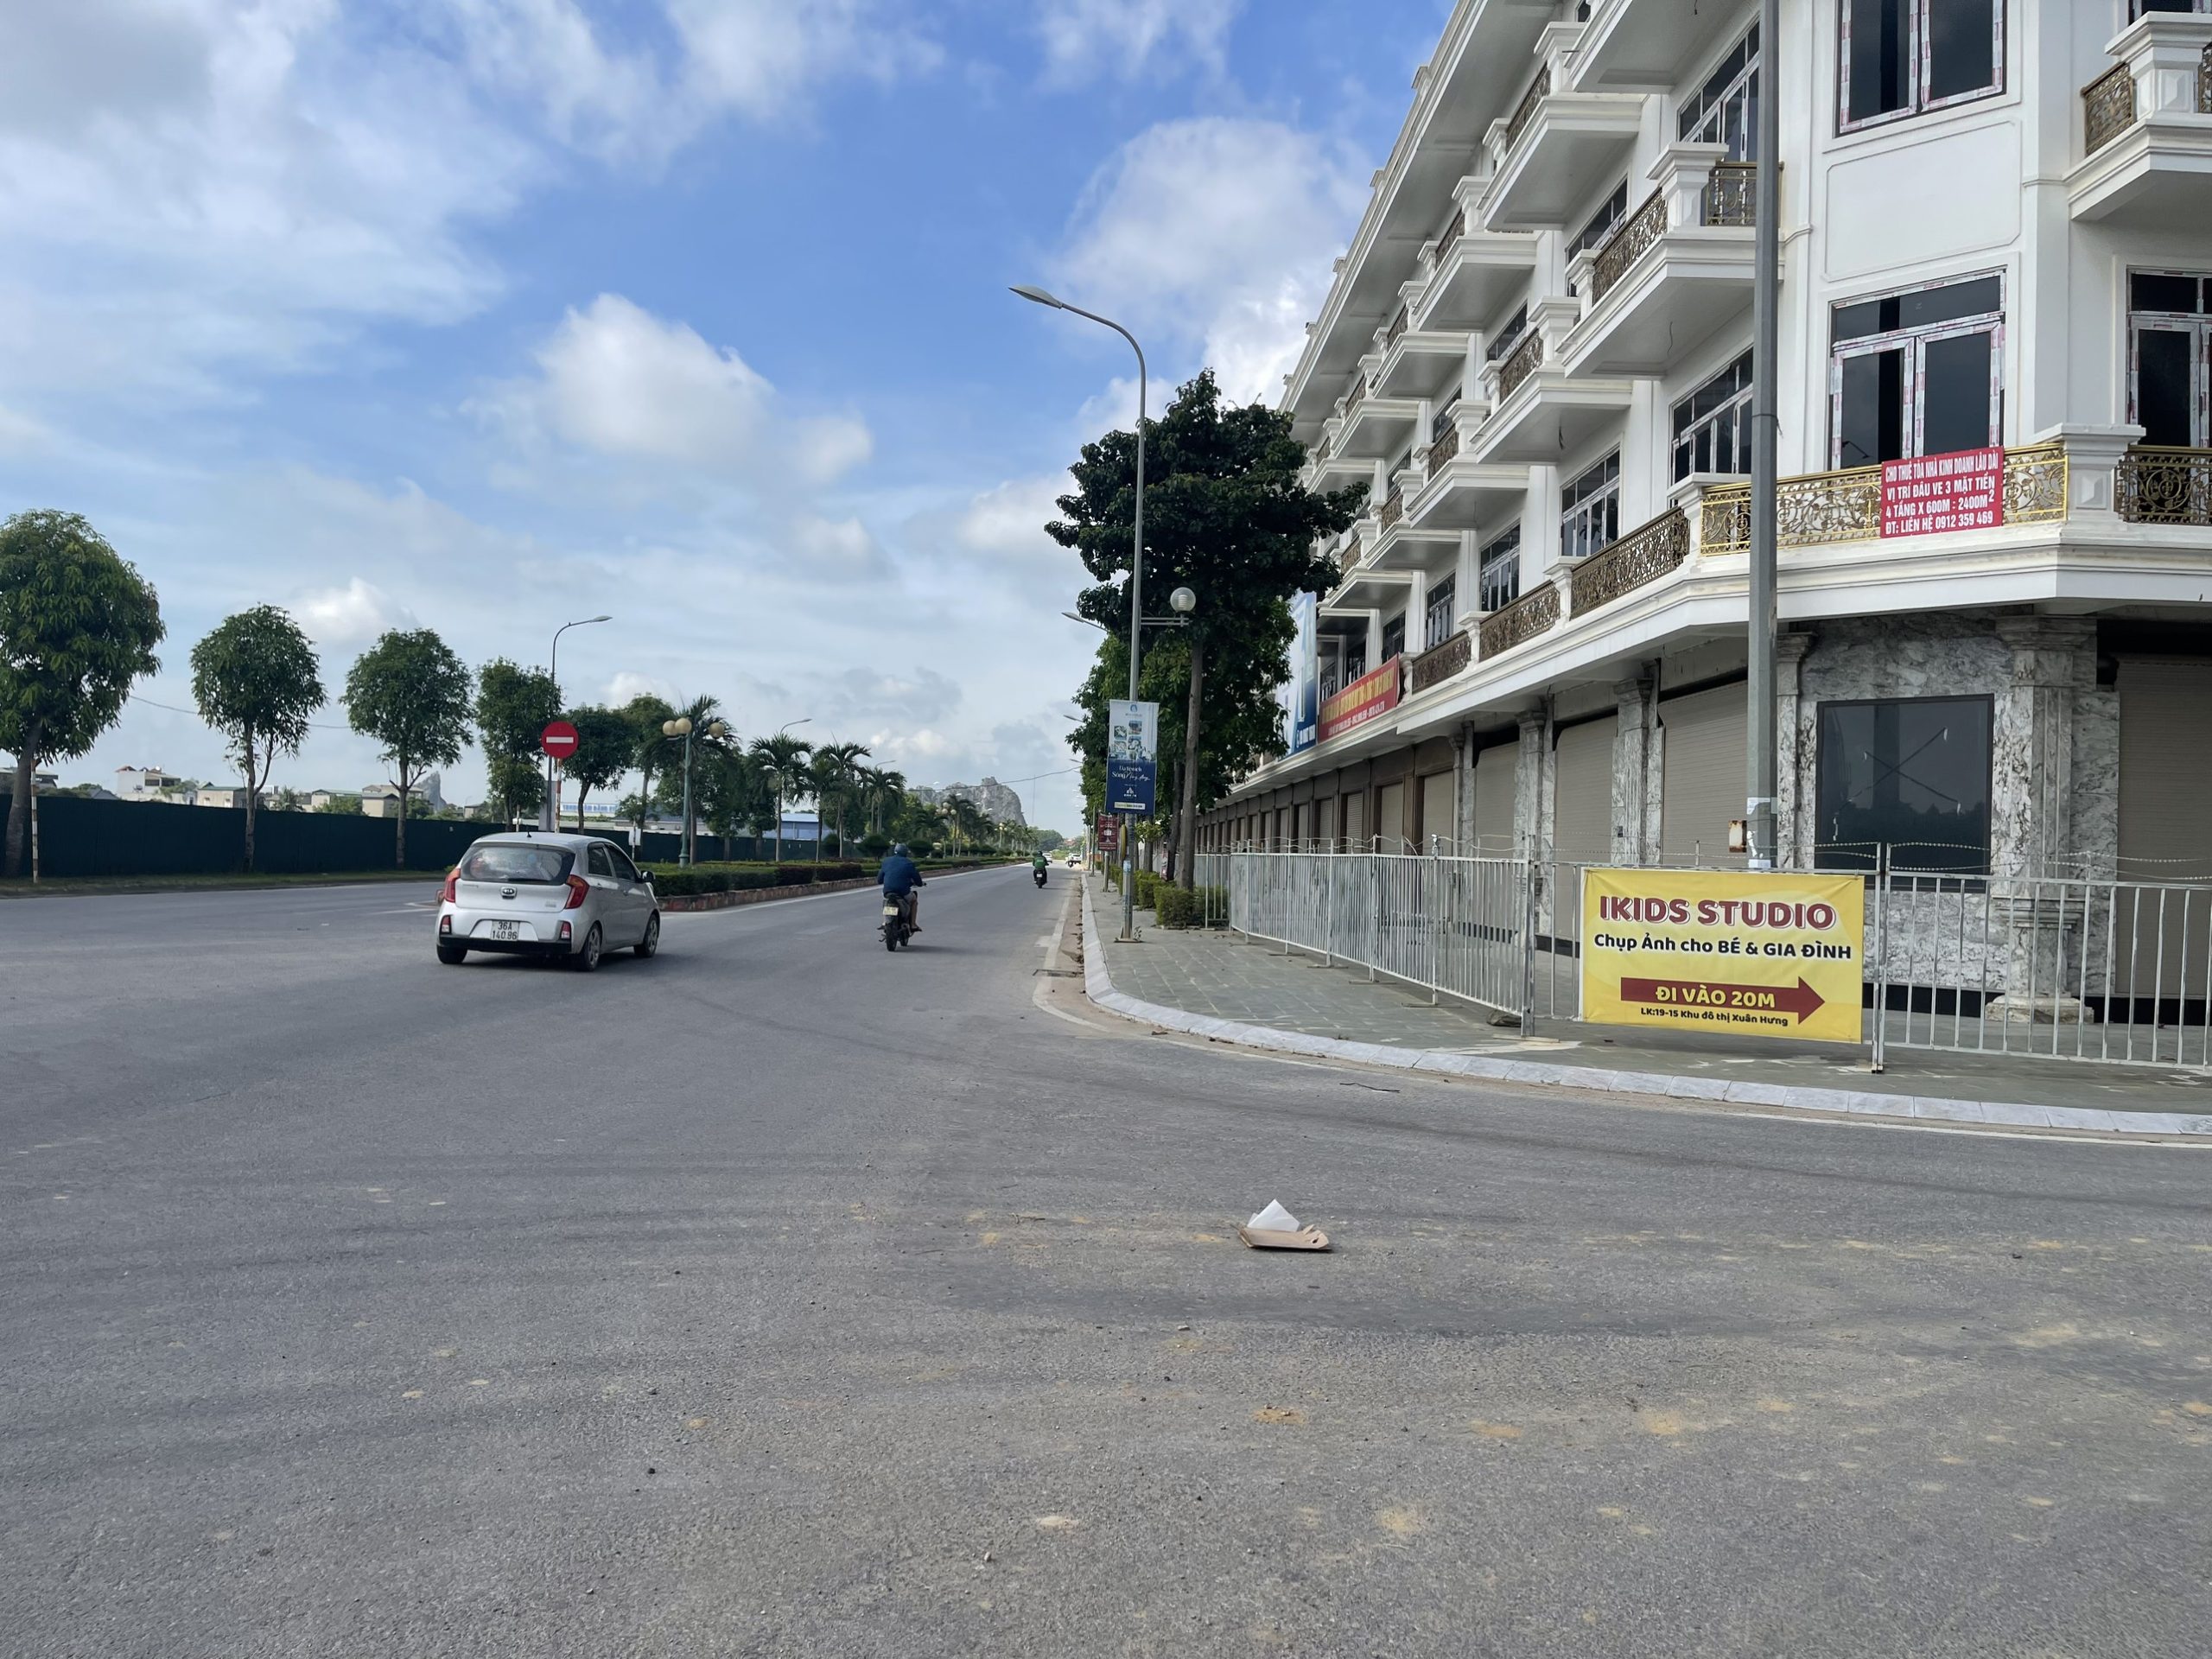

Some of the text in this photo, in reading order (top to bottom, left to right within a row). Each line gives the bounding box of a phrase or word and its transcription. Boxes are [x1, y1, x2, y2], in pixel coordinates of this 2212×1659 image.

[1885, 466, 1897, 482] CHO
[1925, 457, 1938, 478] NHÀ
[1938, 458, 1953, 476] KINH
[1954, 455, 1974, 474] DOANH
[1975, 451, 1987, 472] LÂU
[1987, 449, 1999, 470] DÀI
[1887, 487, 1896, 503] VỊ
[1897, 482, 1911, 499] TRÍ
[1945, 480, 1951, 494] 3
[1954, 476, 1973, 494] MẶT
[1885, 505, 1891, 518] 4
[1917, 502, 1924, 515] X
[1926, 499, 1950, 514] 600M
[1900, 517, 1920, 533] LIÊN
[1922, 514, 1934, 532] HỆ
[1936, 515, 1956, 530] 0912
[1958, 512, 1974, 527] 359
[1976, 511, 1993, 524] 469
[1599, 895, 1837, 931] IKIDS STUDIO
[498, 921, 512, 931] 36A
[1594, 932, 1852, 959] Chụp Ảnh cho BÉ & GIA ĐÌNH
[1656, 983, 1776, 1008] ĐI VÀO 20M
[1640, 1007, 1789, 1027] LK:19-15 Khu đô thị Xuân Hưng
